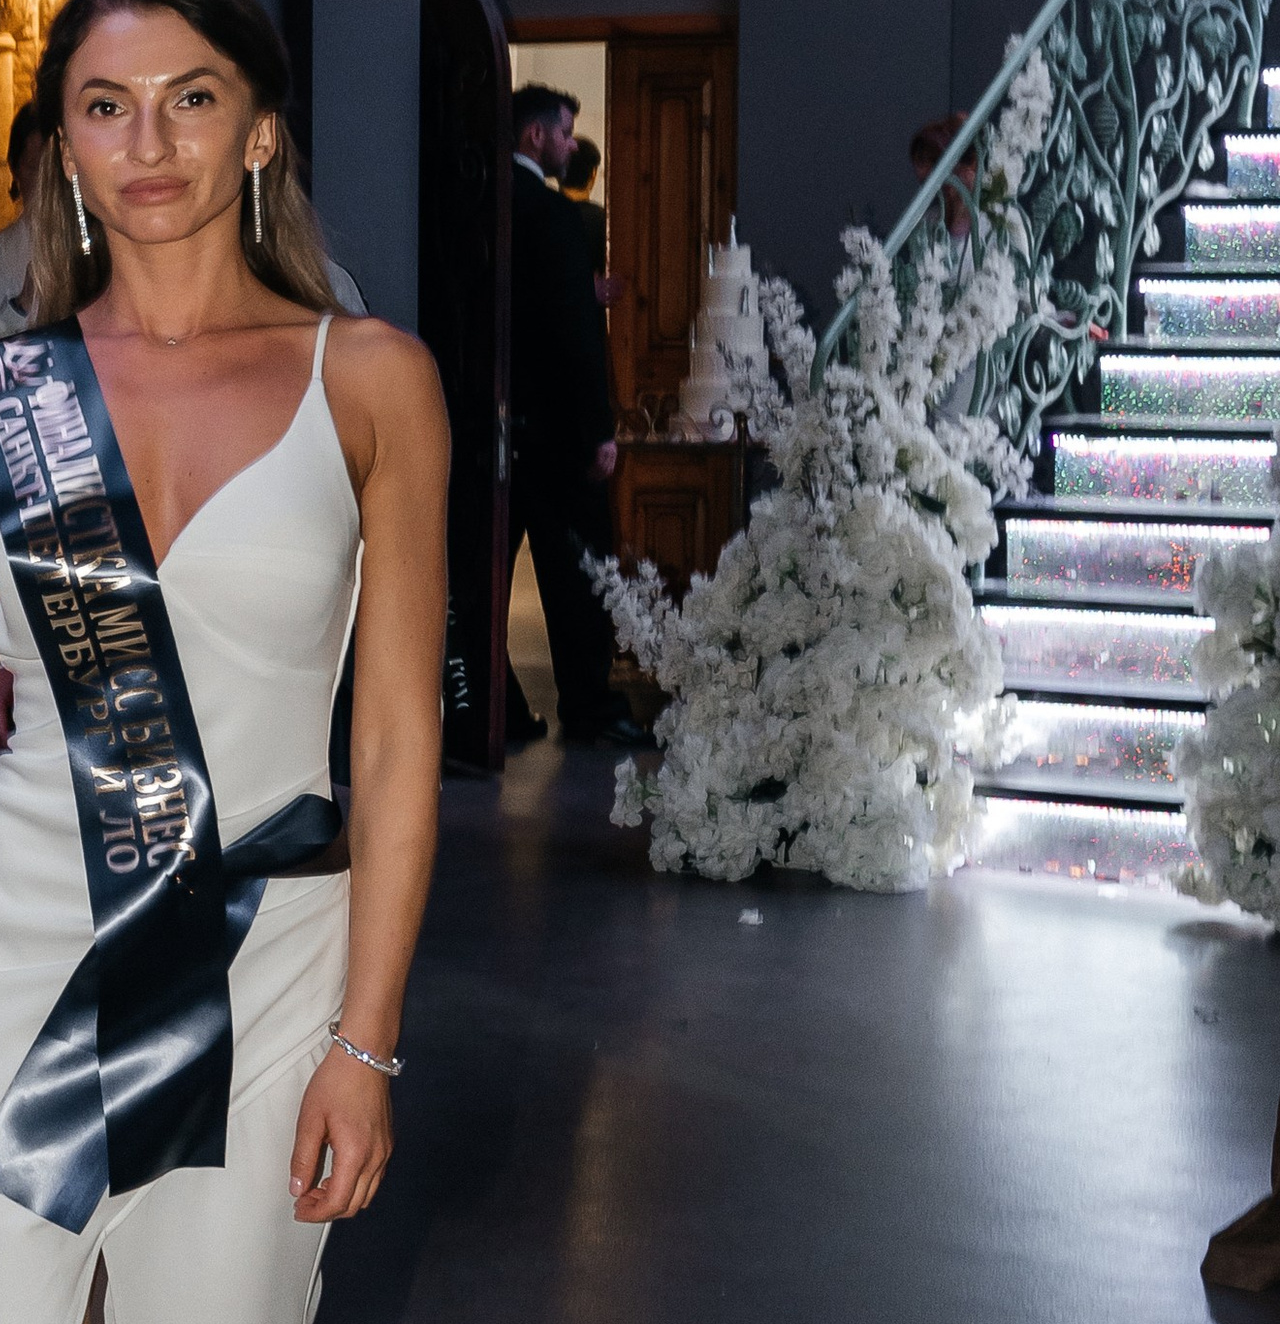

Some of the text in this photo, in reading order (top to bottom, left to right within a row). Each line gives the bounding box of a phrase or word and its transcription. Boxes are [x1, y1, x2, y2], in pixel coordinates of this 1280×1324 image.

[27, 375, 196, 868] ФИНАЛИСТКА МИСС БИЗНЕС
[90, 766, 128, 795] И
[99, 810, 140, 874] ЛО
